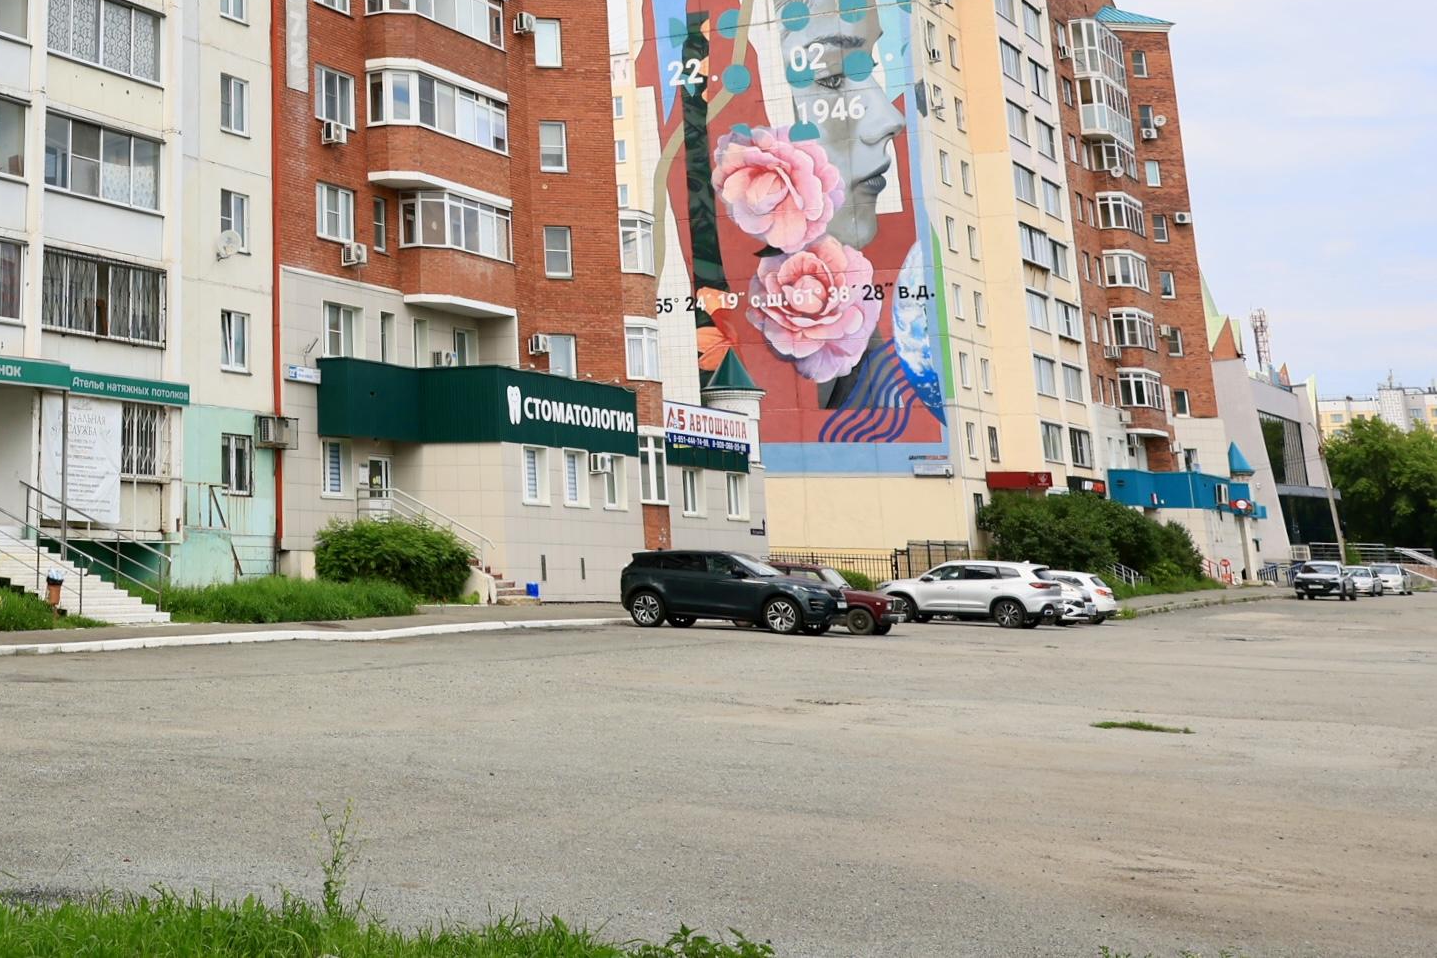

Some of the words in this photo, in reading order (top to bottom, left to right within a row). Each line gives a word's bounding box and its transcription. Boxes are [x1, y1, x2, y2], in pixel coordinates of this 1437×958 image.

[796, 94, 866, 125] 1946
[72, 376, 105, 391] Ателье
[107, 383, 150, 396] натяжных
[151, 388, 189, 400] потолков
[57, 409, 106, 426] РТУАЛЬНАЯ
[523, 396, 635, 433] СТОМАТОЛОГИЯ
[689, 413, 748, 439] АВТОШКОЛА
